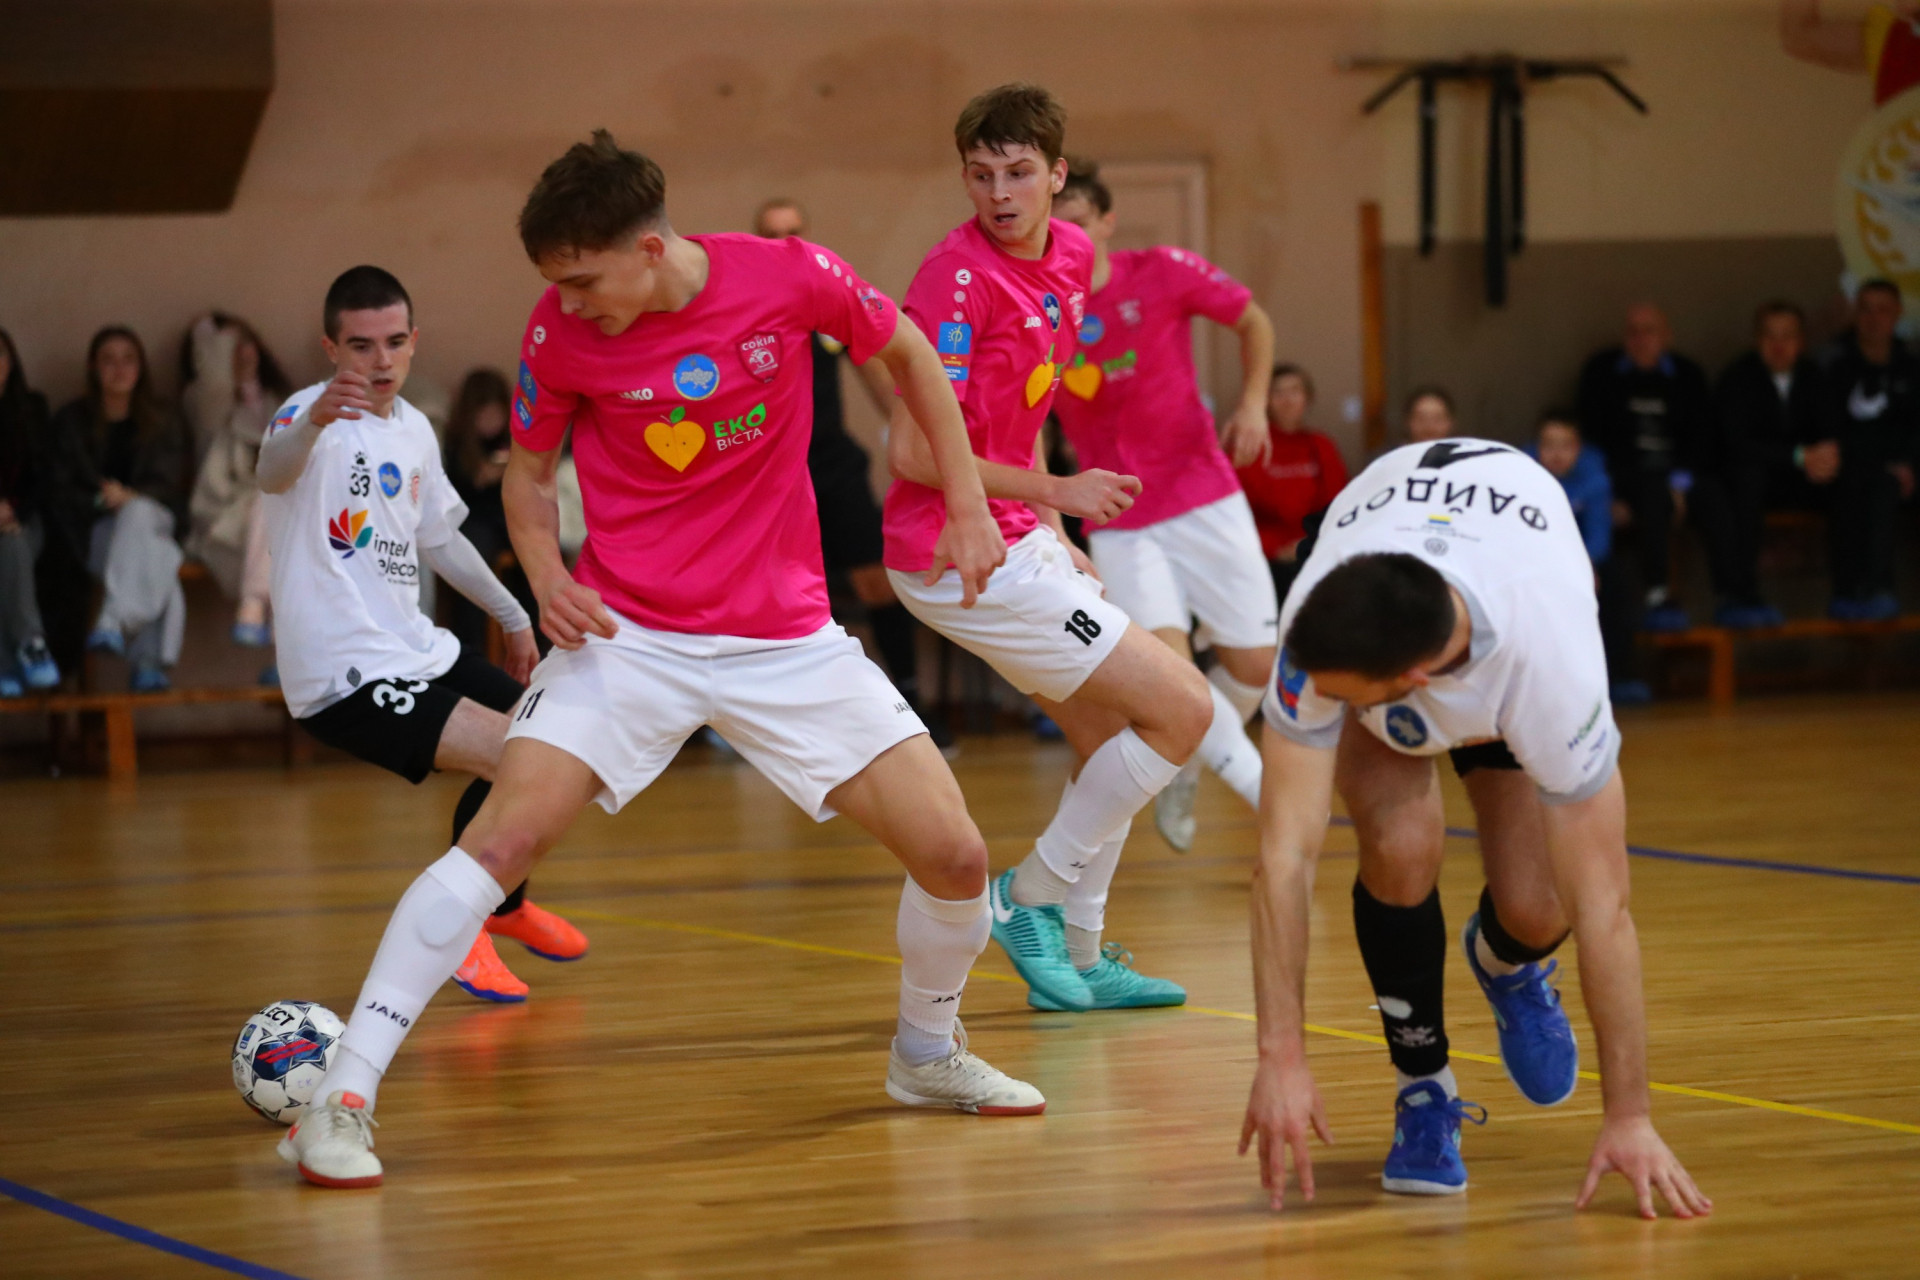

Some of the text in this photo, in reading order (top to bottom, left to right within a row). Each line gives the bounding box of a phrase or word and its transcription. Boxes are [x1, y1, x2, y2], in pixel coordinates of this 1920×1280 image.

[741, 335, 775, 351] СОКІЛ
[713, 402, 767, 438] ЕКО
[716, 428, 764, 451] ВІСТА
[349, 472, 371, 497] 33
[1336, 476, 1548, 531] ФАЙДОР
[374, 533, 410, 557] intel
[1064, 609, 1102, 646] 18
[516, 688, 546, 722] 11
[257, 1006, 296, 1027] LECT
[365, 1001, 410, 1027] JAKO
